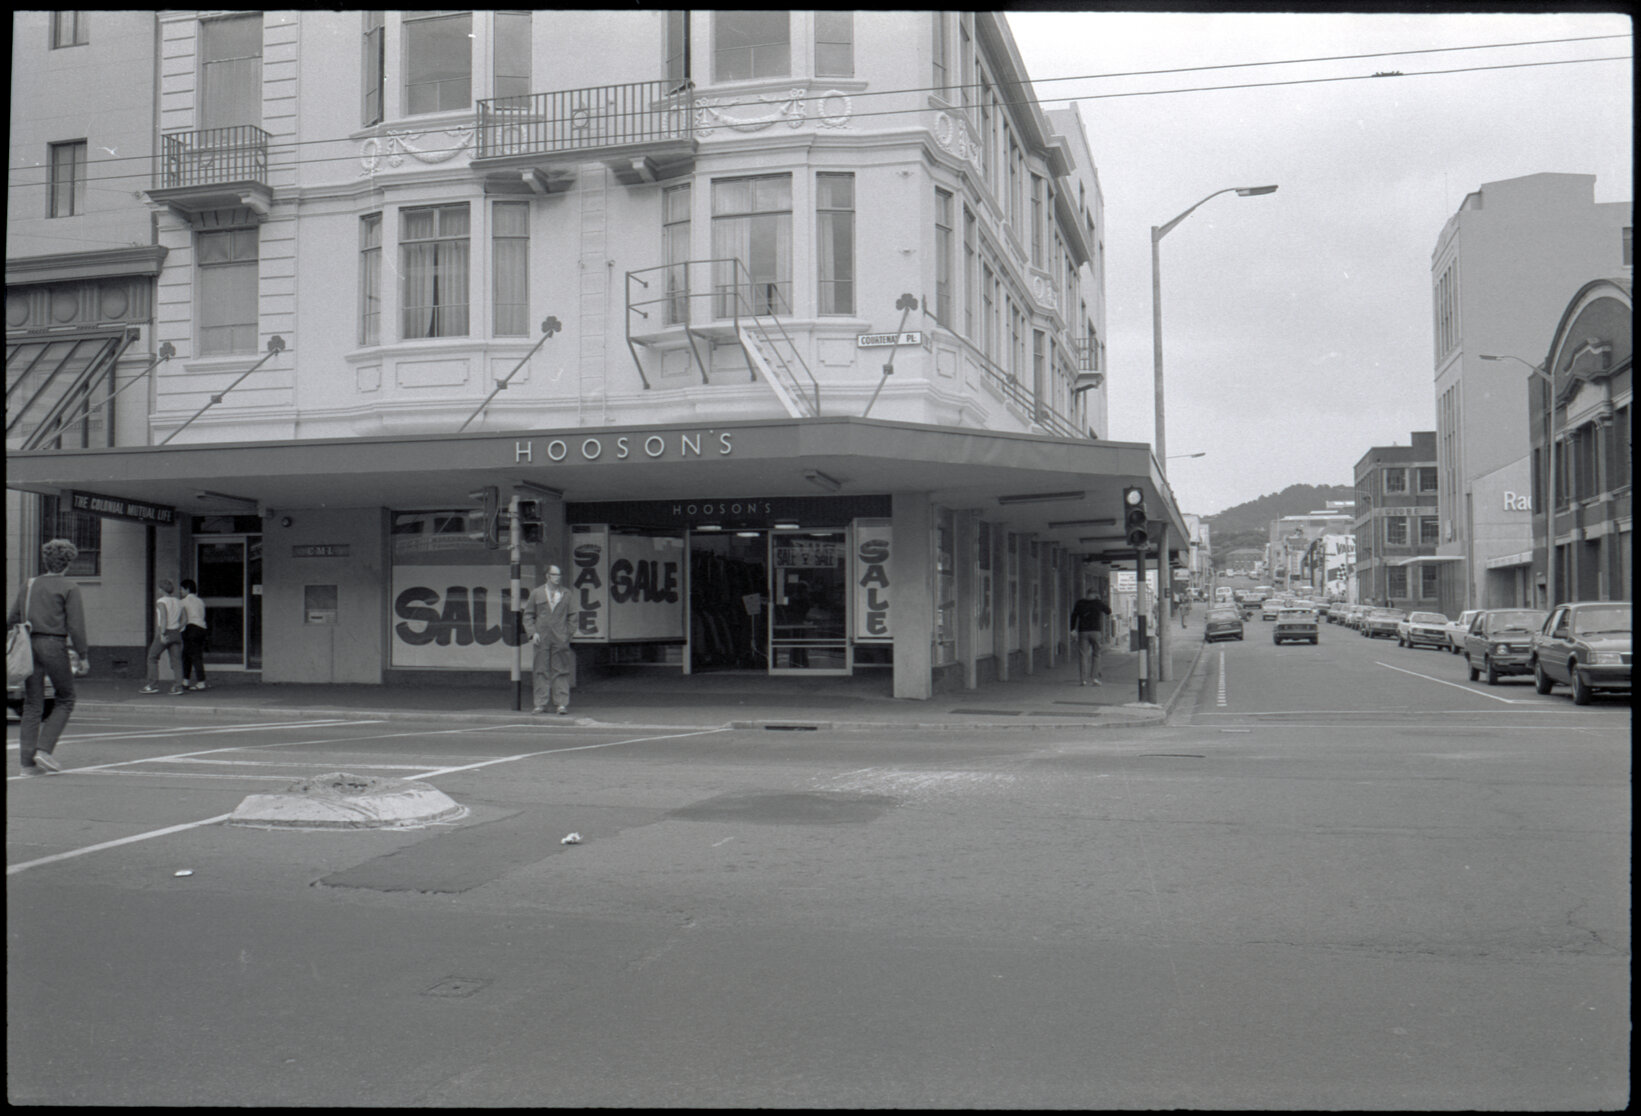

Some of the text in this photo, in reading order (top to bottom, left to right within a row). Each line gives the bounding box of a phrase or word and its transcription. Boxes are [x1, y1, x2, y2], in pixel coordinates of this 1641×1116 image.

[516, 430, 731, 463] HOOSON'S
[74, 495, 171, 522] THE COLONIAL MUTUAL LIFE
[673, 501, 771, 515] HOOSON'S
[777, 549, 796, 566] SALE
[573, 544, 602, 635] SALE
[610, 558, 678, 604] SALE
[858, 539, 890, 635] SALE
